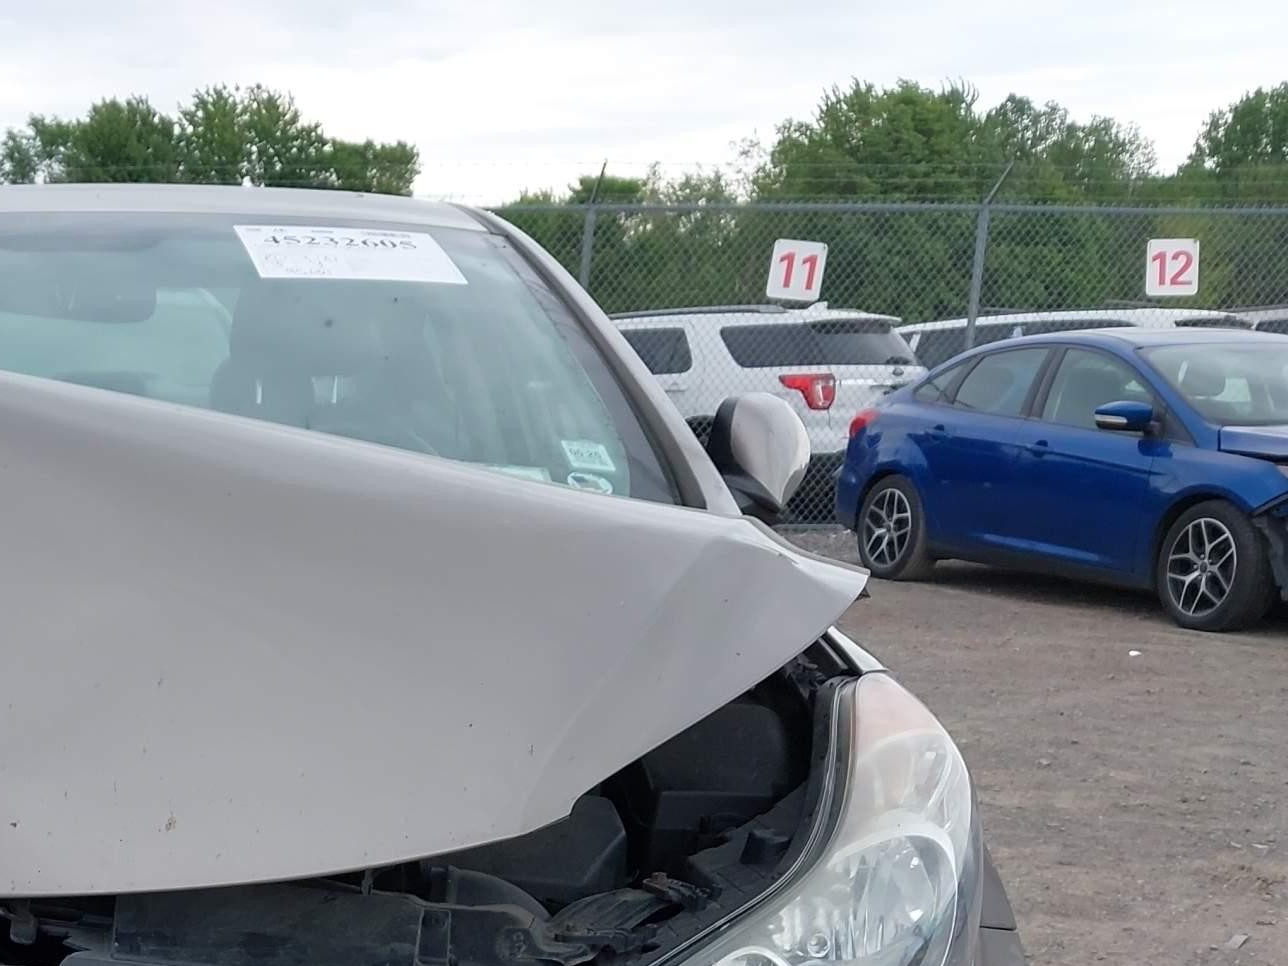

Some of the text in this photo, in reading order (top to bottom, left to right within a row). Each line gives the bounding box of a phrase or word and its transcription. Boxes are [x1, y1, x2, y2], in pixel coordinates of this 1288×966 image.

[263, 235, 417, 250] 45232605
[778, 252, 818, 290] 11
[1151, 250, 1193, 286] 12
